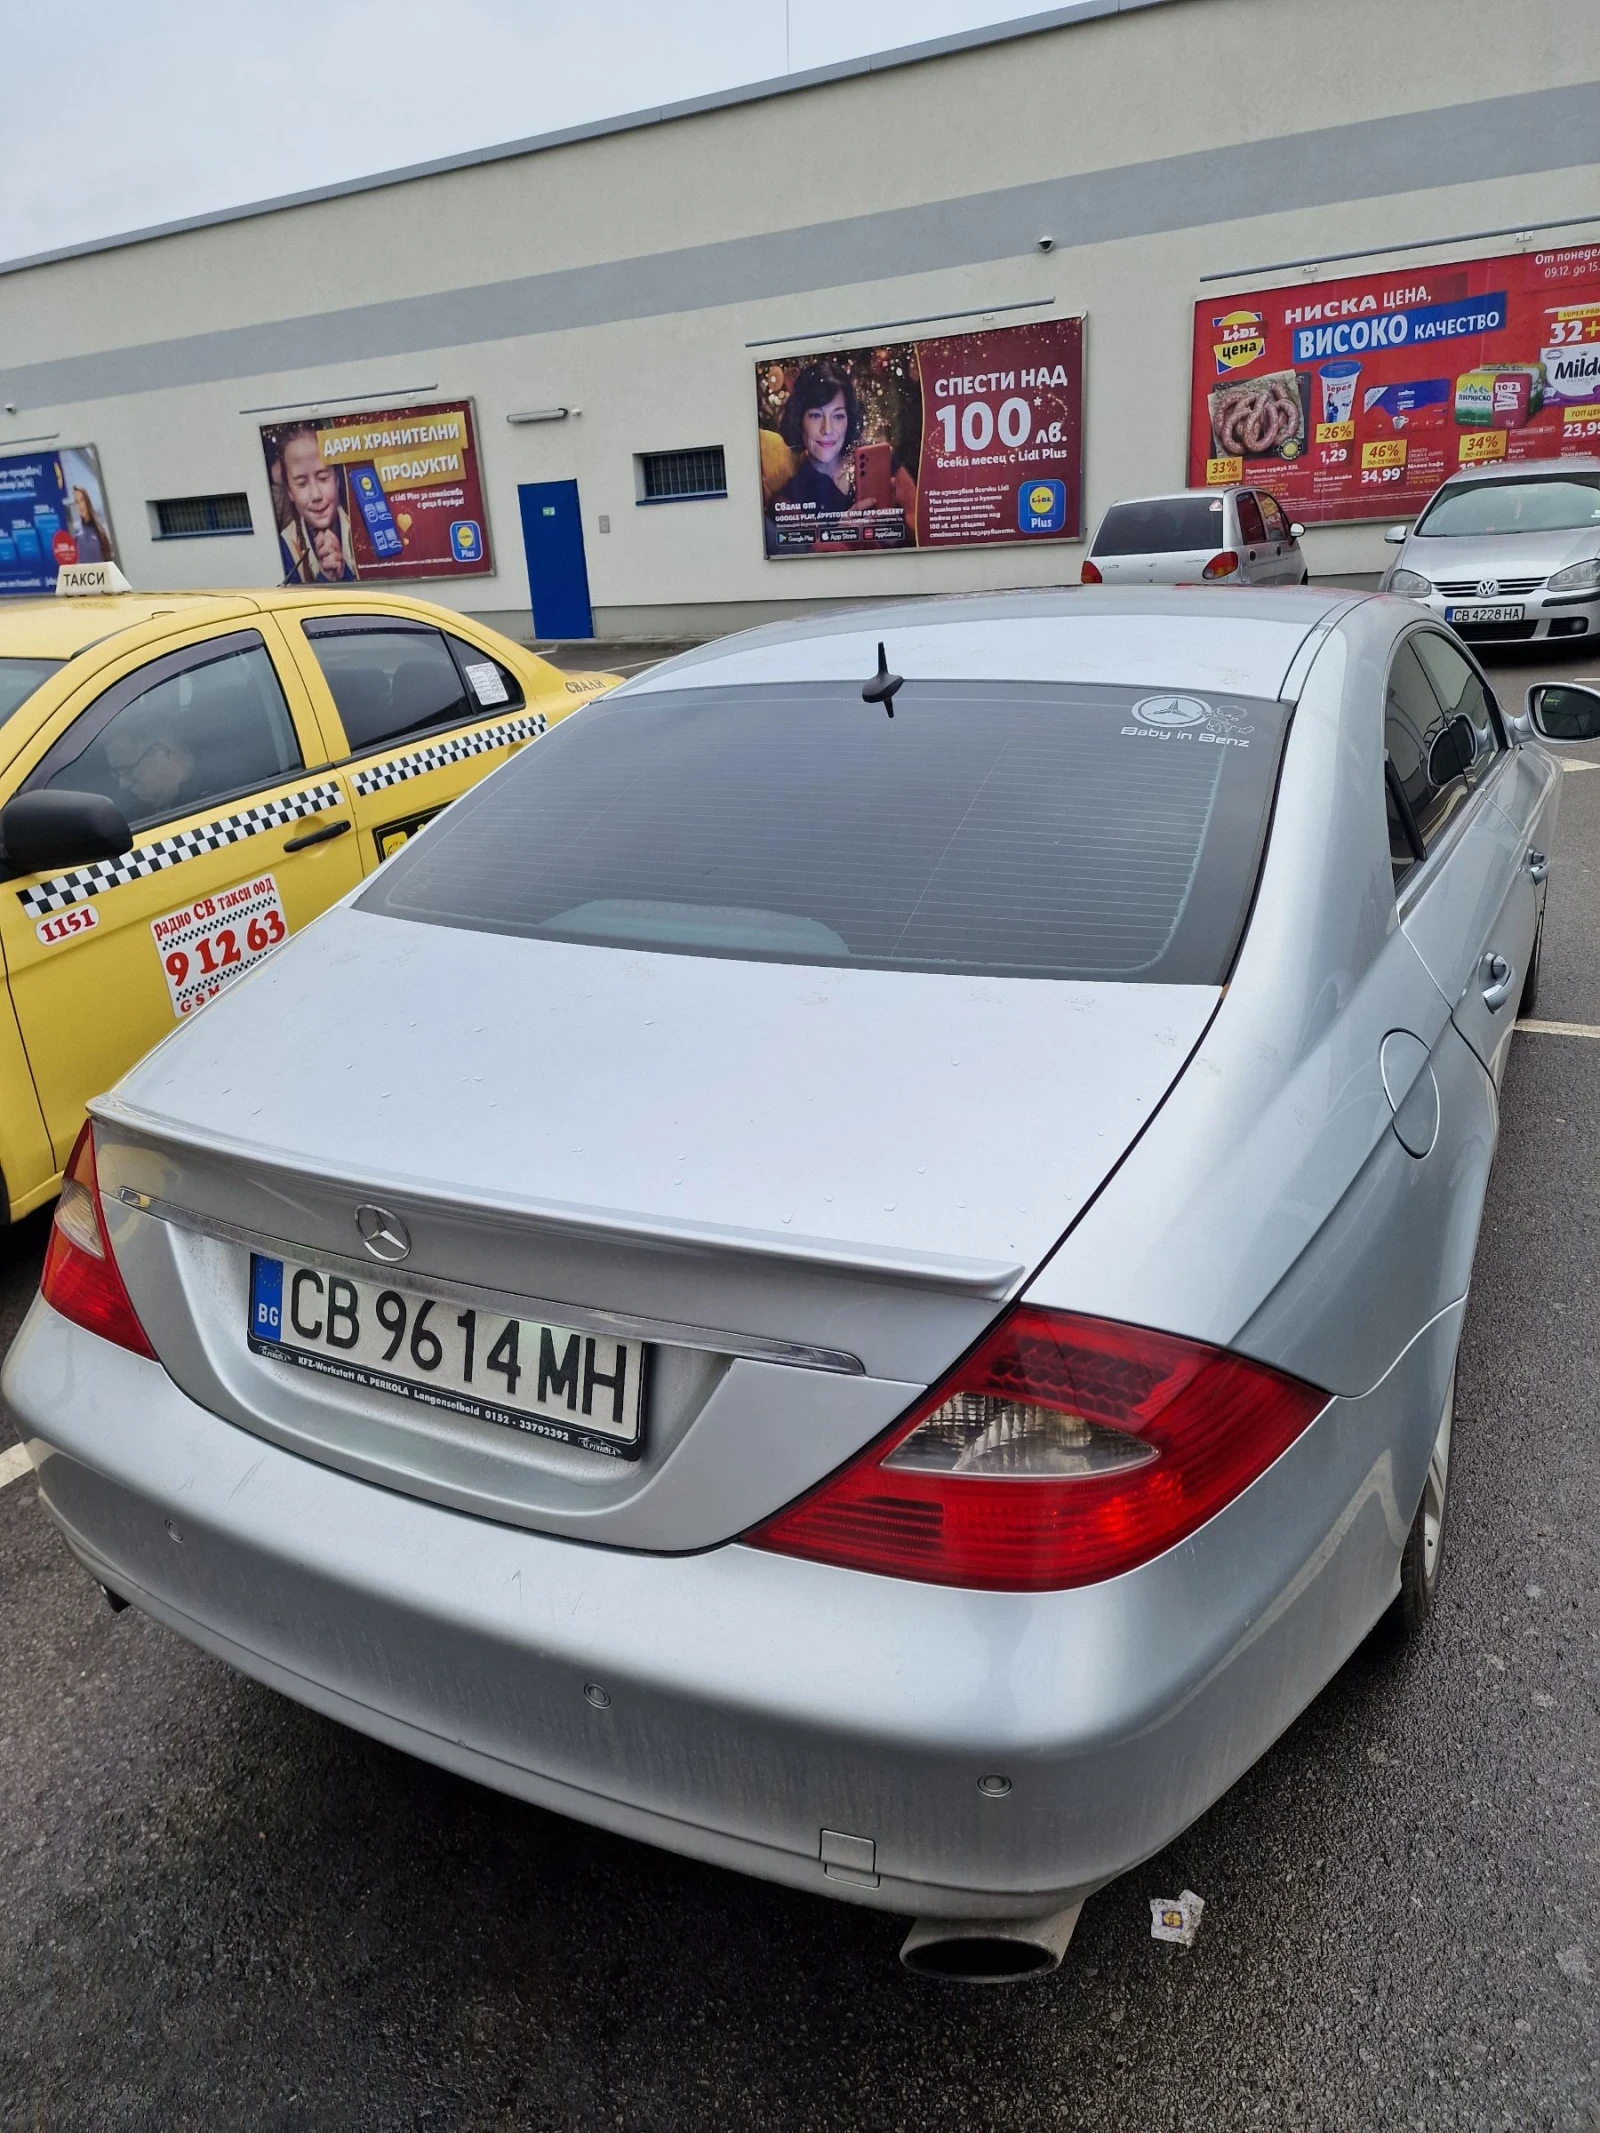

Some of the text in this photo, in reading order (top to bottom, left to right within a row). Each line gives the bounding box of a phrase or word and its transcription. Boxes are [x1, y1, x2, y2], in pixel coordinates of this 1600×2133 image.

[1535, 253, 1554, 265] От
[1573, 265, 1586, 277] до
[1285, 285, 1432, 325] НИСКА ЦЕНА,
[1300, 311, 1500, 359] ВИСОКО КАЧЕСТВО
[1222, 341, 1257, 360] цена
[934, 364, 1068, 397] СПЕСТИ НАД
[324, 422, 460, 458] ДАРИ ХРАНИТЕЛНИ
[1035, 421, 1068, 444] лв.
[1319, 425, 1352, 440] -26%
[1467, 434, 1499, 451] 34%
[936, 455, 969, 468] всеки
[971, 454, 1007, 465] месец
[1018, 448, 1040, 461] Lidl
[1042, 448, 1067, 460] Plus
[1320, 448, 1348, 465] 1,29
[1369, 443, 1399, 458] 46%
[380, 454, 459, 482] ПРОДУКТИ
[1211, 460, 1238, 475] 33%
[775, 501, 817, 512] Свали от
[1031, 518, 1053, 528] Plus
[63, 572, 105, 587] ТАКСИ
[1472, 608, 1501, 621] 4228
[1120, 726, 1250, 748] Baby in Benz
[153, 877, 275, 942] радио СВ такси оод
[40, 908, 96, 943] 1151
[166, 910, 286, 987] 9 12 63
[258, 1302, 279, 1327] BG
[375, 1290, 522, 1395] 9614
[298, 1355, 355, 1380] KFZ-Werkstatt
[356, 1373, 368, 1384] M.
[369, 1377, 409, 1396] PERKOLA
[414, 1390, 480, 1416] Langenselbold
[485, 1411, 510, 1425] 0152
[519, 1419, 570, 1441] 33792392
